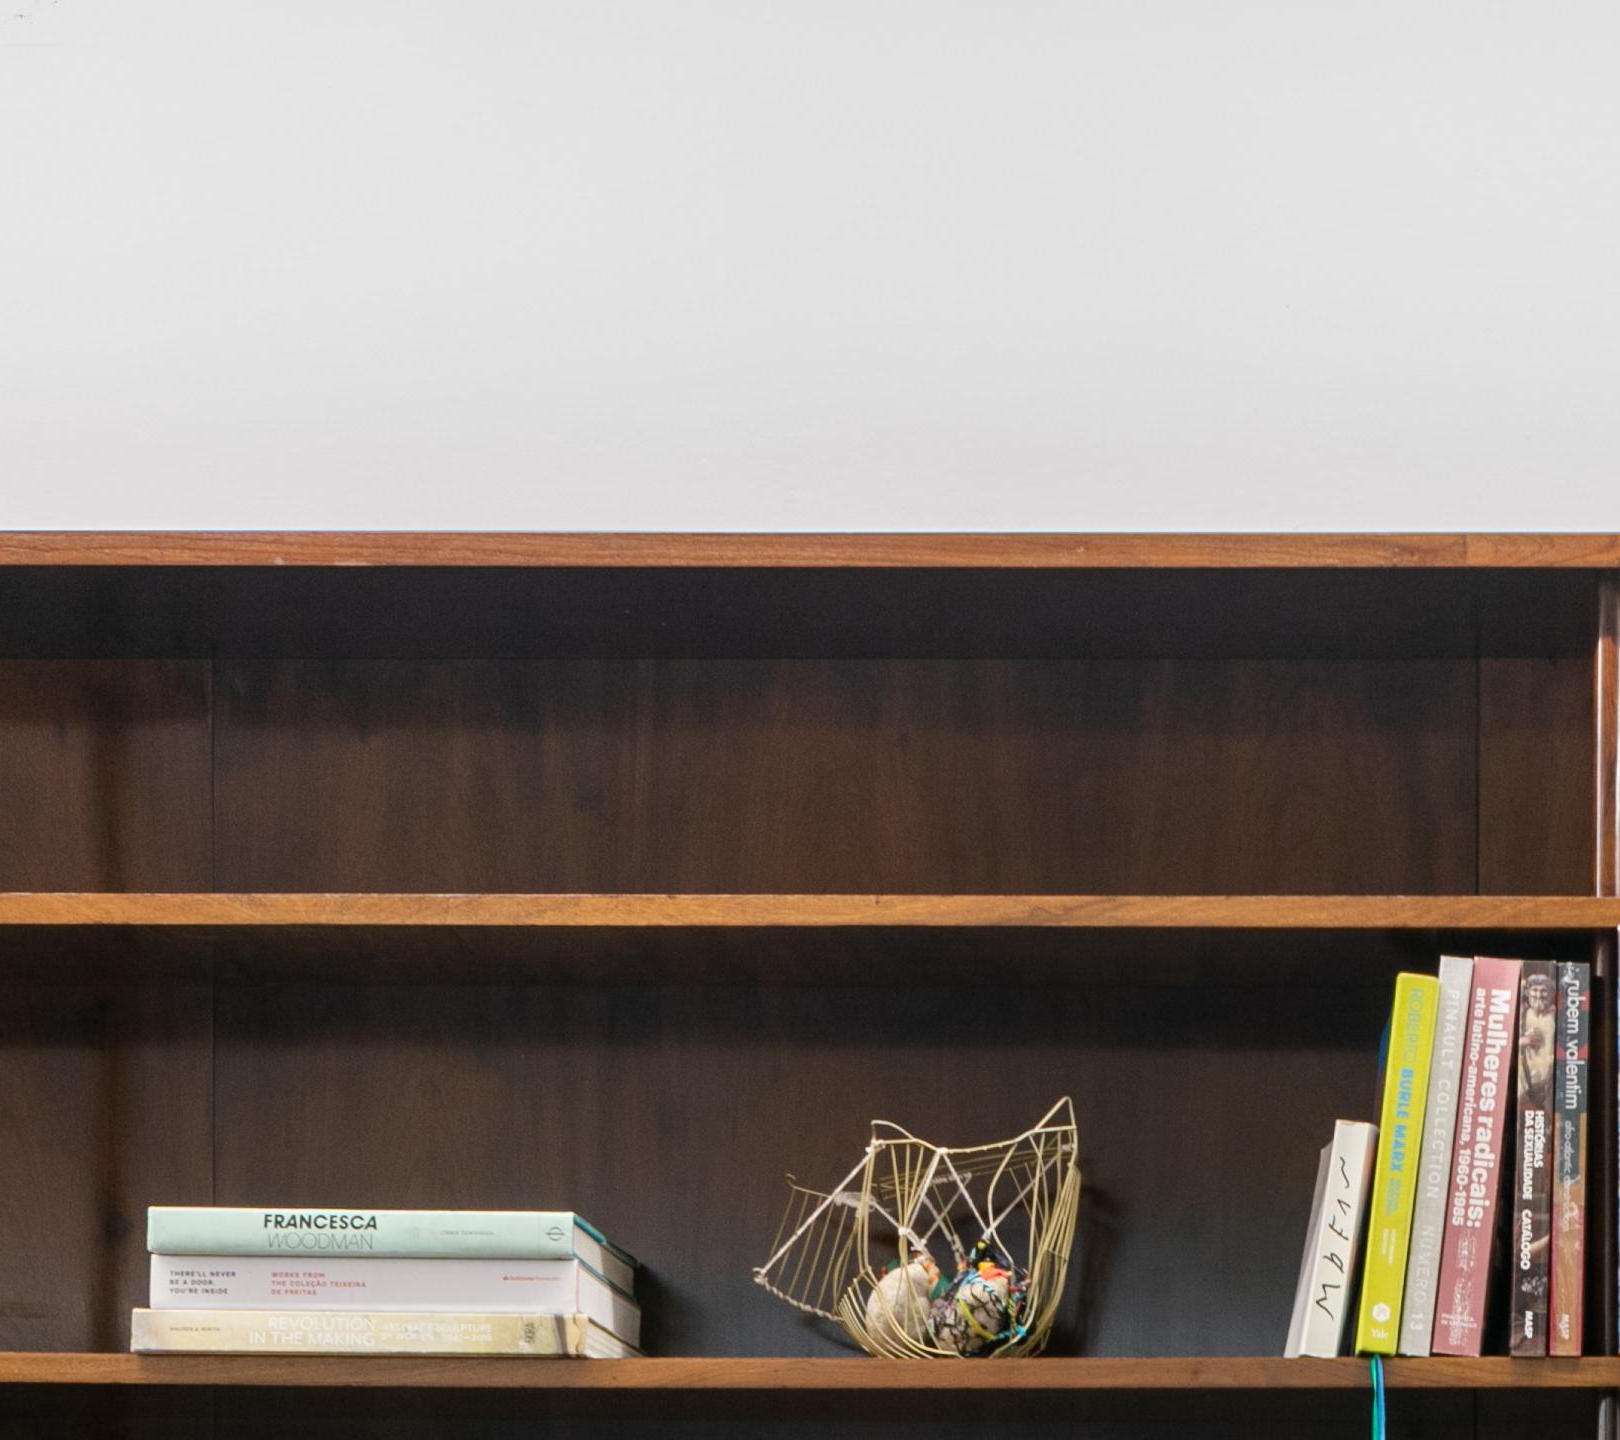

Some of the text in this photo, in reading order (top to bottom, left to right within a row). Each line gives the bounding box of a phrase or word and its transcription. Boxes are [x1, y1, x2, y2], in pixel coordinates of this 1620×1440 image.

[1401, 986, 1426, 1064] ROBERTO
[1441, 989, 1461, 1067] PINAULT
[1565, 979, 1587, 1110] rubem valentim
[1394, 1066, 1415, 1121] BURLE
[1451, 987, 1487, 1227] arte latino-americana, 1960-1985
[1465, 988, 1513, 1229] Mulheres radicais:
[1389, 1124, 1408, 1173] MARX
[1426, 1079, 1452, 1198] COLLECTION
[1533, 1110, 1547, 1168] HISTÓRIAS
[1519, 1110, 1535, 1270] DA SEXUALIDADE CATÁLOGO
[264, 1214, 378, 1230] FRANCESCA
[268, 1232, 374, 1250] WOODMAN
[170, 1270, 207, 1278] THERE'LL
[271, 1271, 300, 1279] WORKS
[289, 1279, 327, 1289] COLEÇÃO
[249, 1331, 375, 1346] IN THE MAKING
[267, 1315, 376, 1331] REVOLUTION
[1524, 1310, 1534, 1339] MASP
